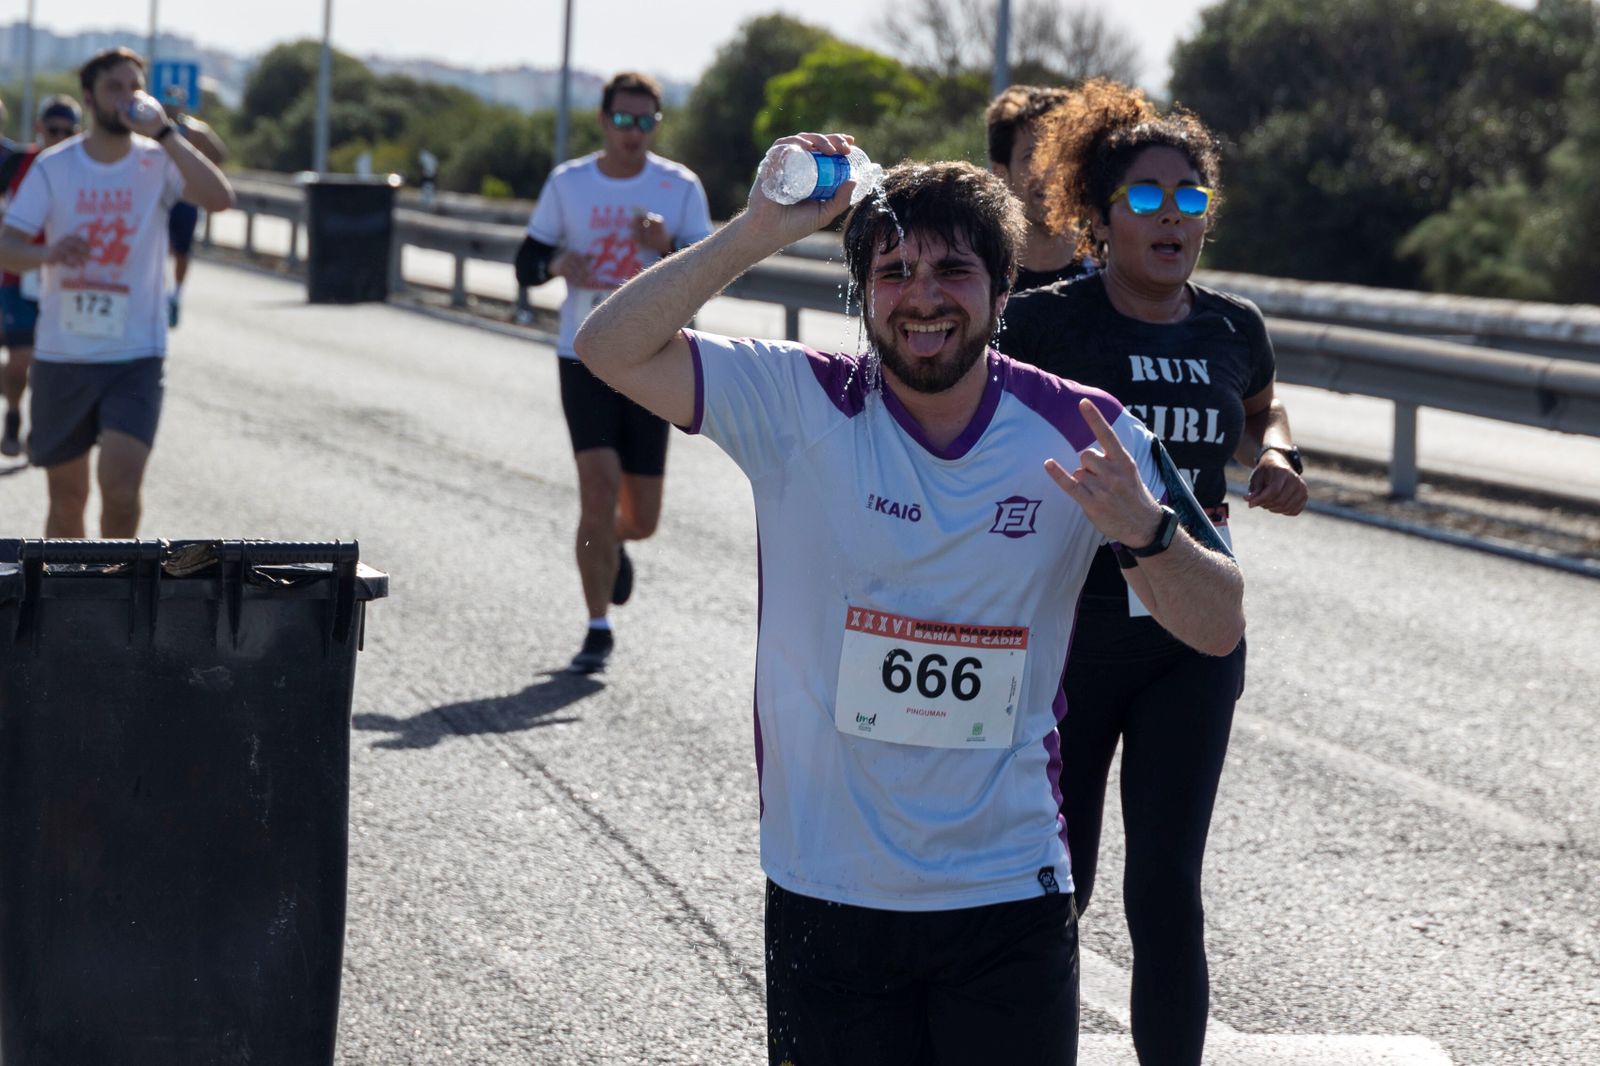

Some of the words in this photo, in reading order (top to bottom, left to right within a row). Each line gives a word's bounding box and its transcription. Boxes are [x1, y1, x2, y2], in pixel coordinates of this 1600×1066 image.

[75, 293, 112, 315] 172
[1128, 355, 1210, 384] RUN
[915, 623, 956, 634] MEDIA
[960, 635, 977, 644] DE
[882, 648, 983, 701] 666
[906, 707, 947, 718] PINGUMAN
